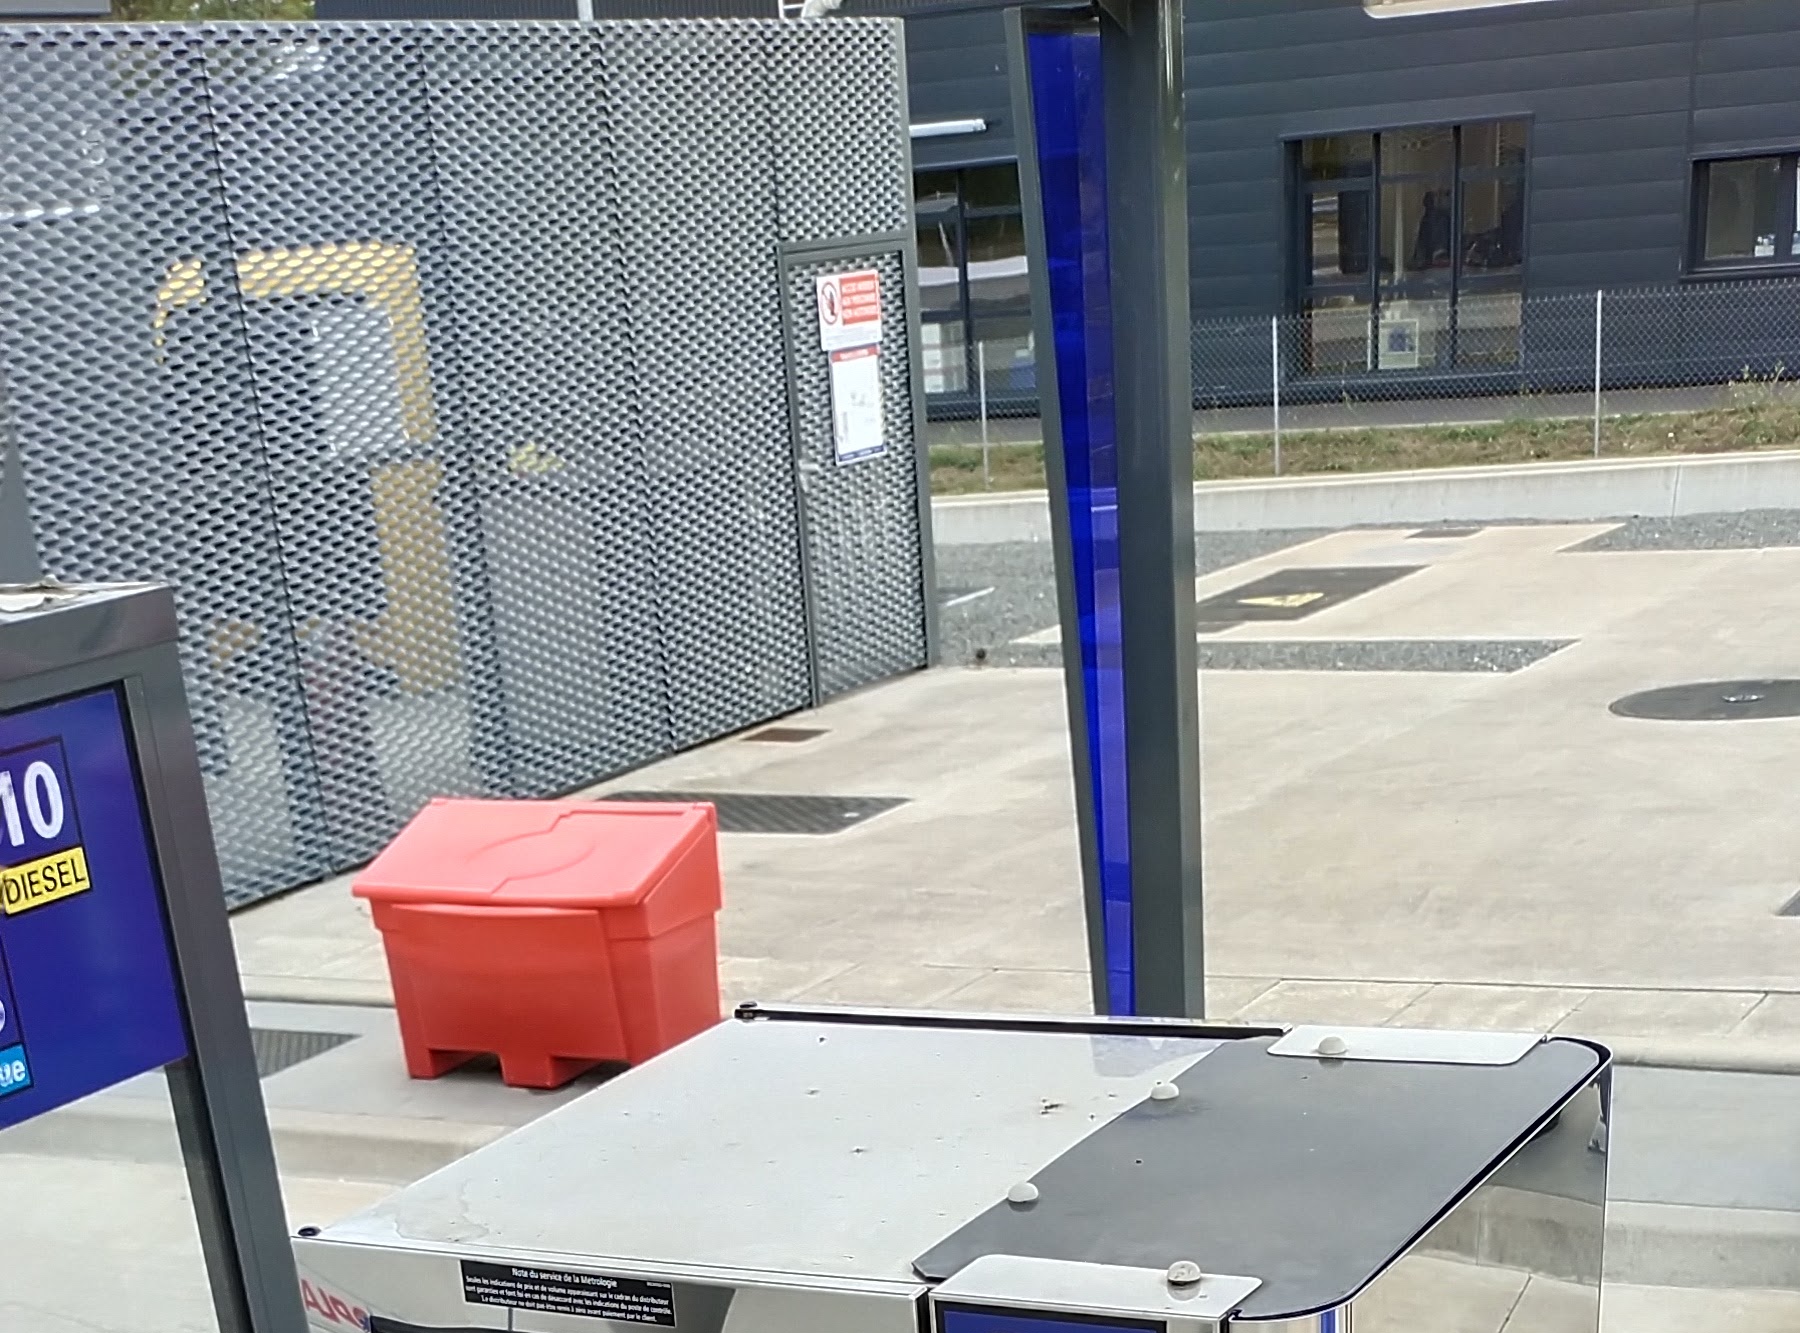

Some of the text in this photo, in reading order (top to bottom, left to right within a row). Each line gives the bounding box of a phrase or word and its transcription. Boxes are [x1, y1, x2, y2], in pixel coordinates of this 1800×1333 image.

[4, 857, 86, 905] DIESEL
[511, 1267, 528, 1277] Note
[528, 1269, 538, 1278] du
[538, 1270, 562, 1281] service
[562, 1273, 571, 1282] de
[572, 1274, 580, 1283] la
